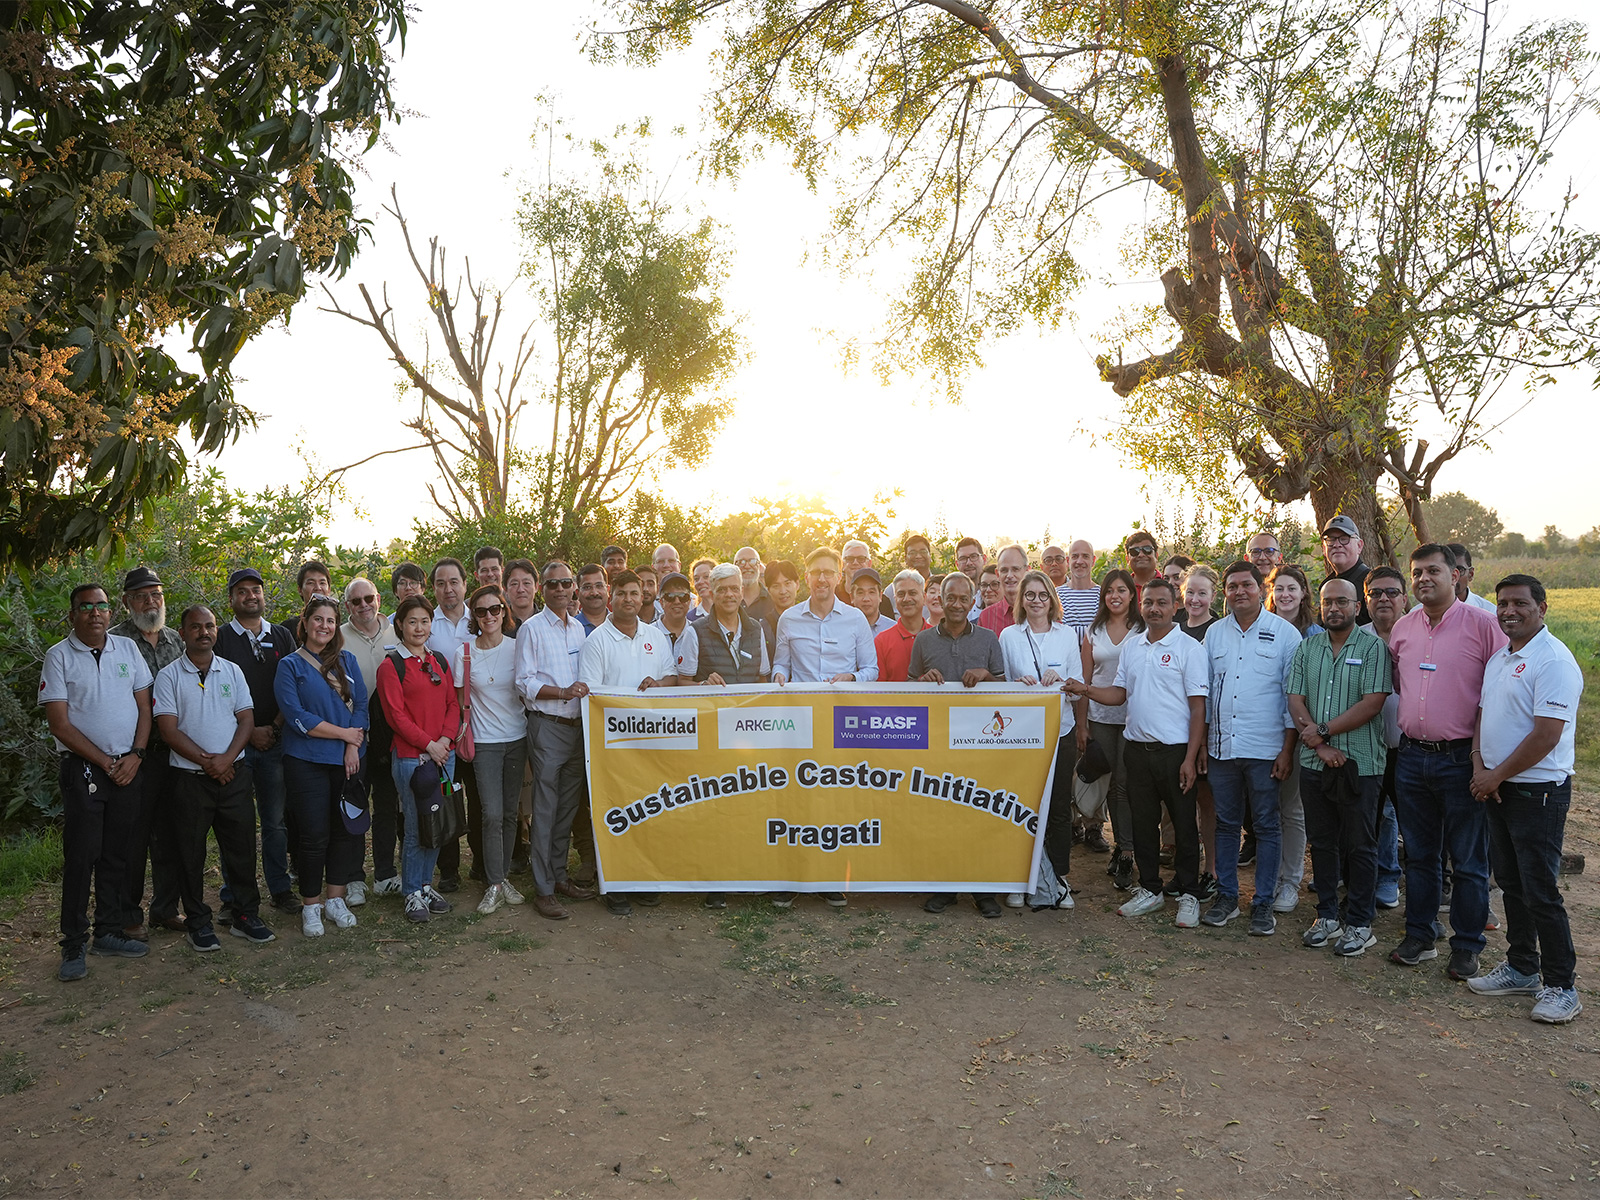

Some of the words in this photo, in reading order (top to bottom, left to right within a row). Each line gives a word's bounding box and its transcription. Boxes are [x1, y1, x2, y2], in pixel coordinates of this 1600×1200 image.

[607, 716, 696, 734] Solidaridad
[735, 719, 796, 732] ARKEMA
[870, 716, 917, 729] BASF
[856, 732, 881, 740] create
[882, 732, 921, 741] chemistry
[952, 738, 976, 746] JAYANT
[976, 737, 1027, 745] AGRO-ORGANICS
[605, 763, 788, 835] Sustainable
[796, 762, 904, 791] Castor
[910, 767, 1039, 836] Initiative
[767, 819, 881, 851] Pragati
